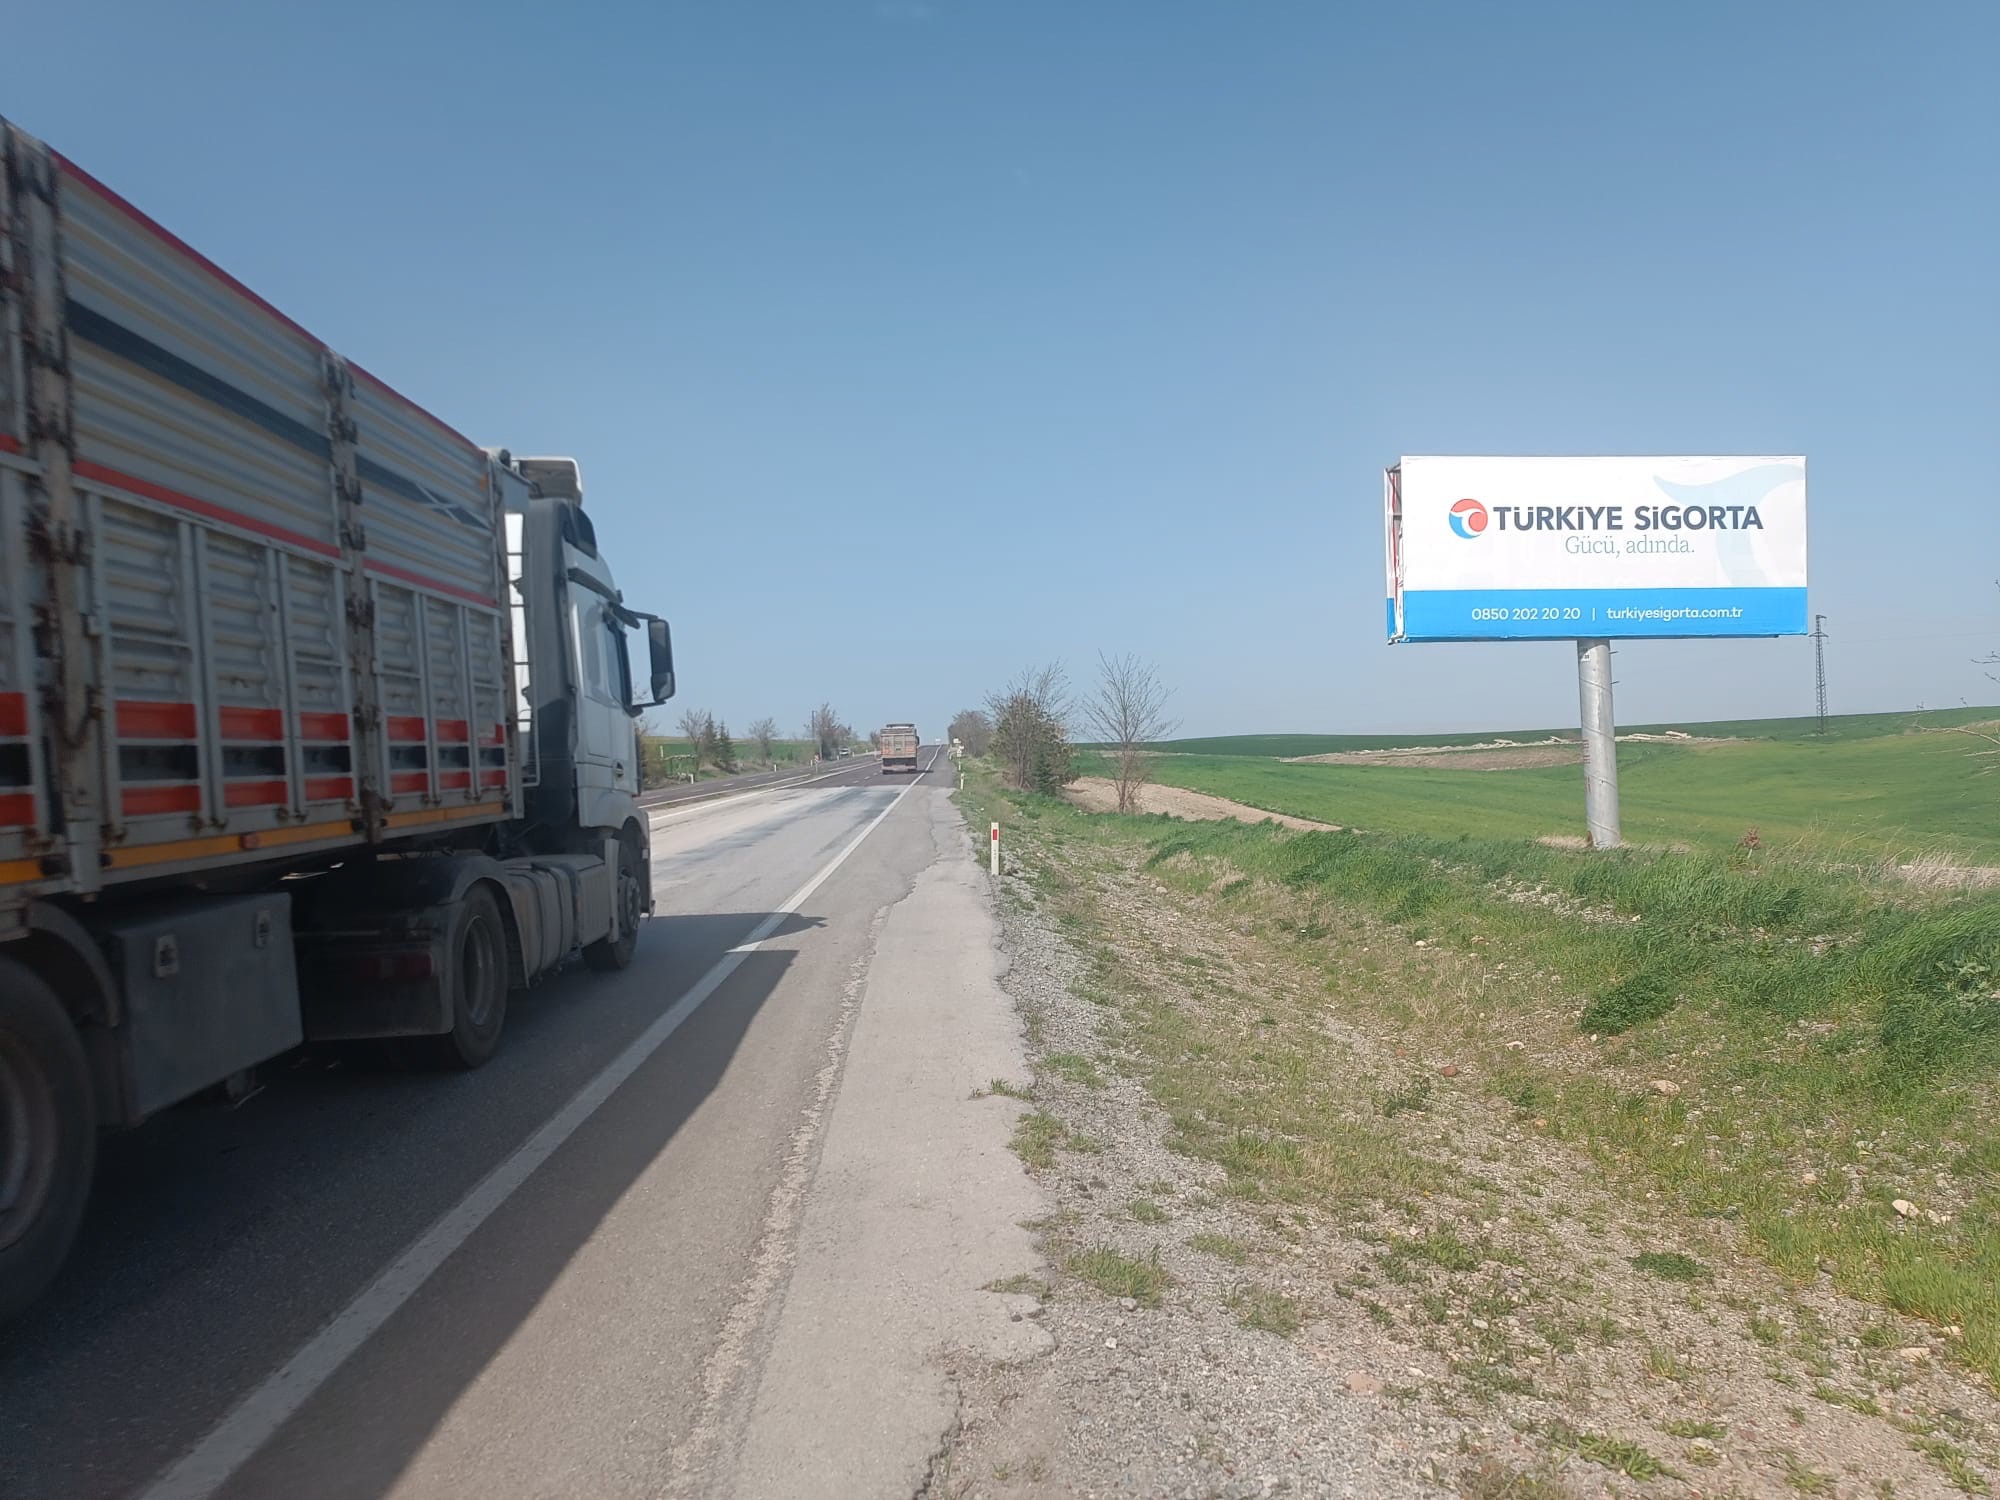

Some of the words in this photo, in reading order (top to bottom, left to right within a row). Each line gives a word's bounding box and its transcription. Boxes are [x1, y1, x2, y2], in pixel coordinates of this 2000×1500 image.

[1565, 535, 1620, 559] Gücü,
[1626, 534, 1695, 554] adında.
[1471, 608, 1509, 620] 0850
[1512, 607, 1538, 620] 202
[1541, 607, 1560, 620] 20
[1563, 607, 1581, 620] 20
[1606, 606, 1743, 622] turkiyesigorta.com.tr
